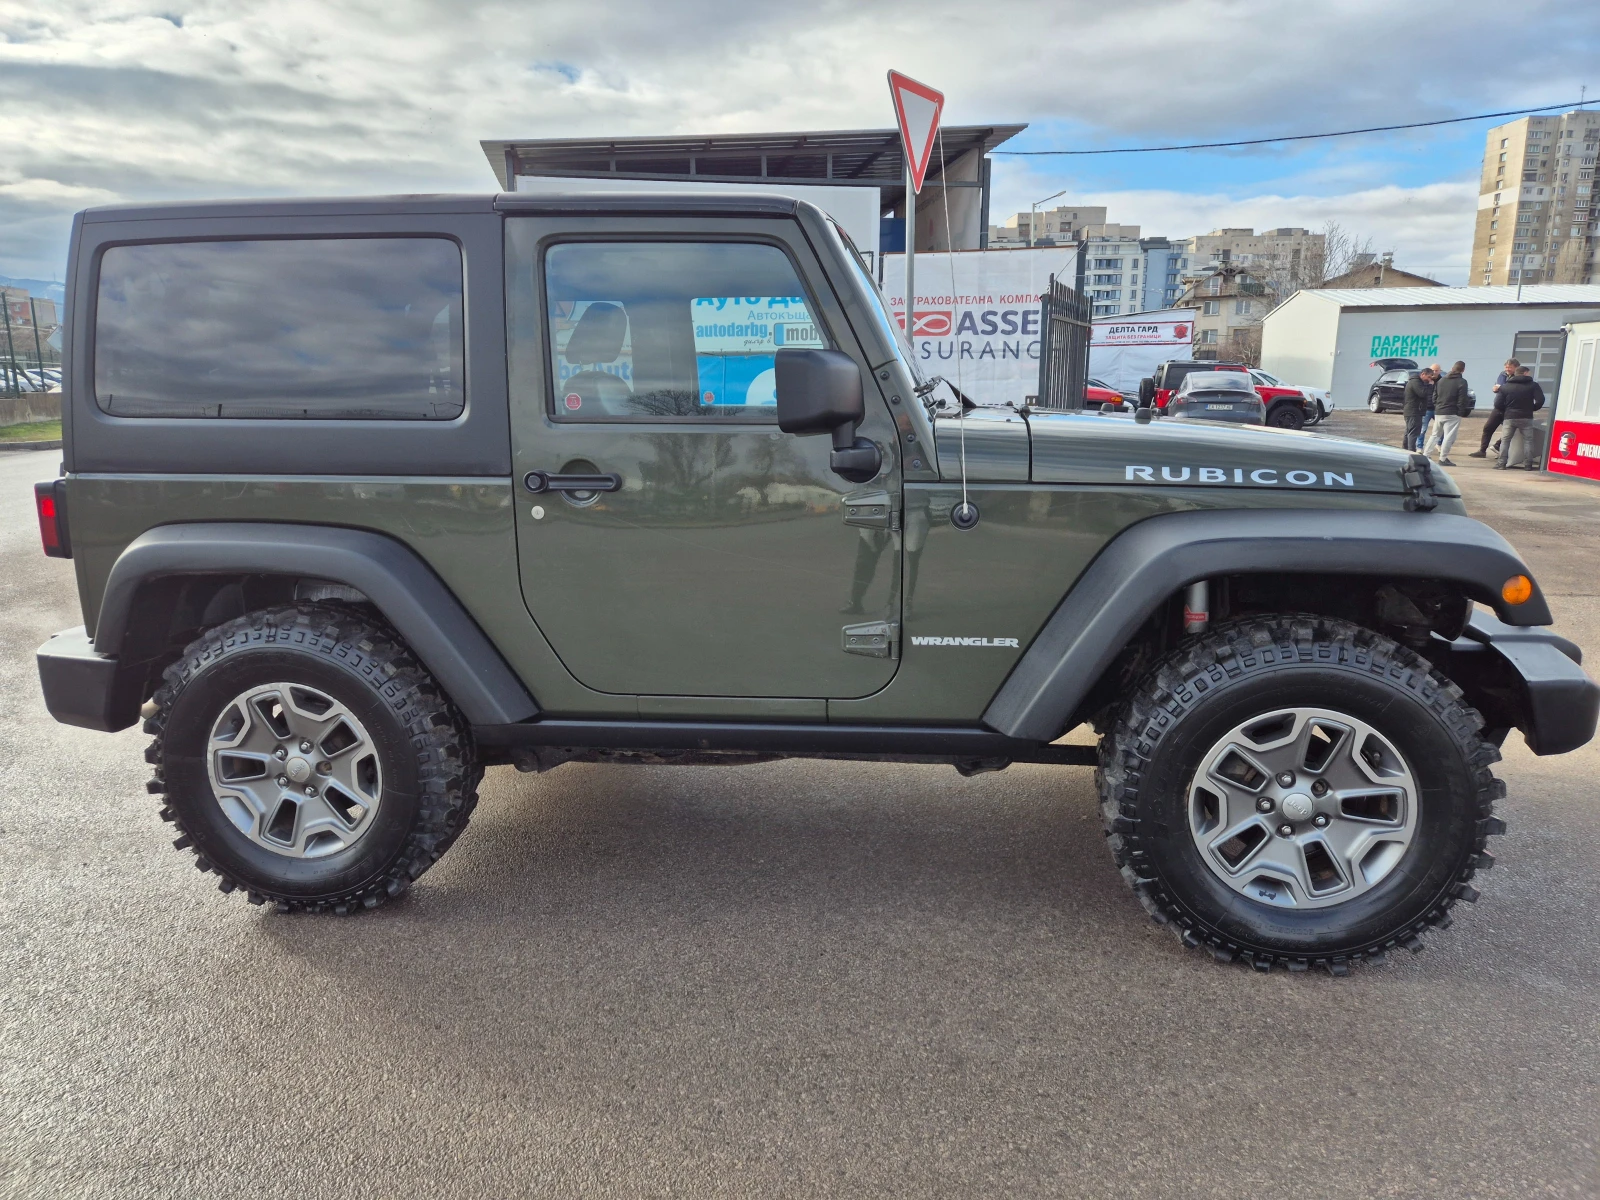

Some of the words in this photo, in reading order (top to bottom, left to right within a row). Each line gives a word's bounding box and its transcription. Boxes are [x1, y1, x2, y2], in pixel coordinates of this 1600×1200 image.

[890, 295, 994, 306] ЗАТРАХОВАТЕЛНА
[955, 310, 1040, 335] ASSE
[785, 325, 820, 341] mob
[1108, 326, 1136, 334] ДЕЛТА
[1137, 325, 1159, 333] ГАРД
[1371, 334, 1440, 347] ПАРКИНГ
[912, 340, 1040, 360] SURANC
[1370, 346, 1439, 358] КЛИЕНТИ
[1125, 465, 1354, 486] RUBICON
[910, 636, 1019, 648] WRANGLER
